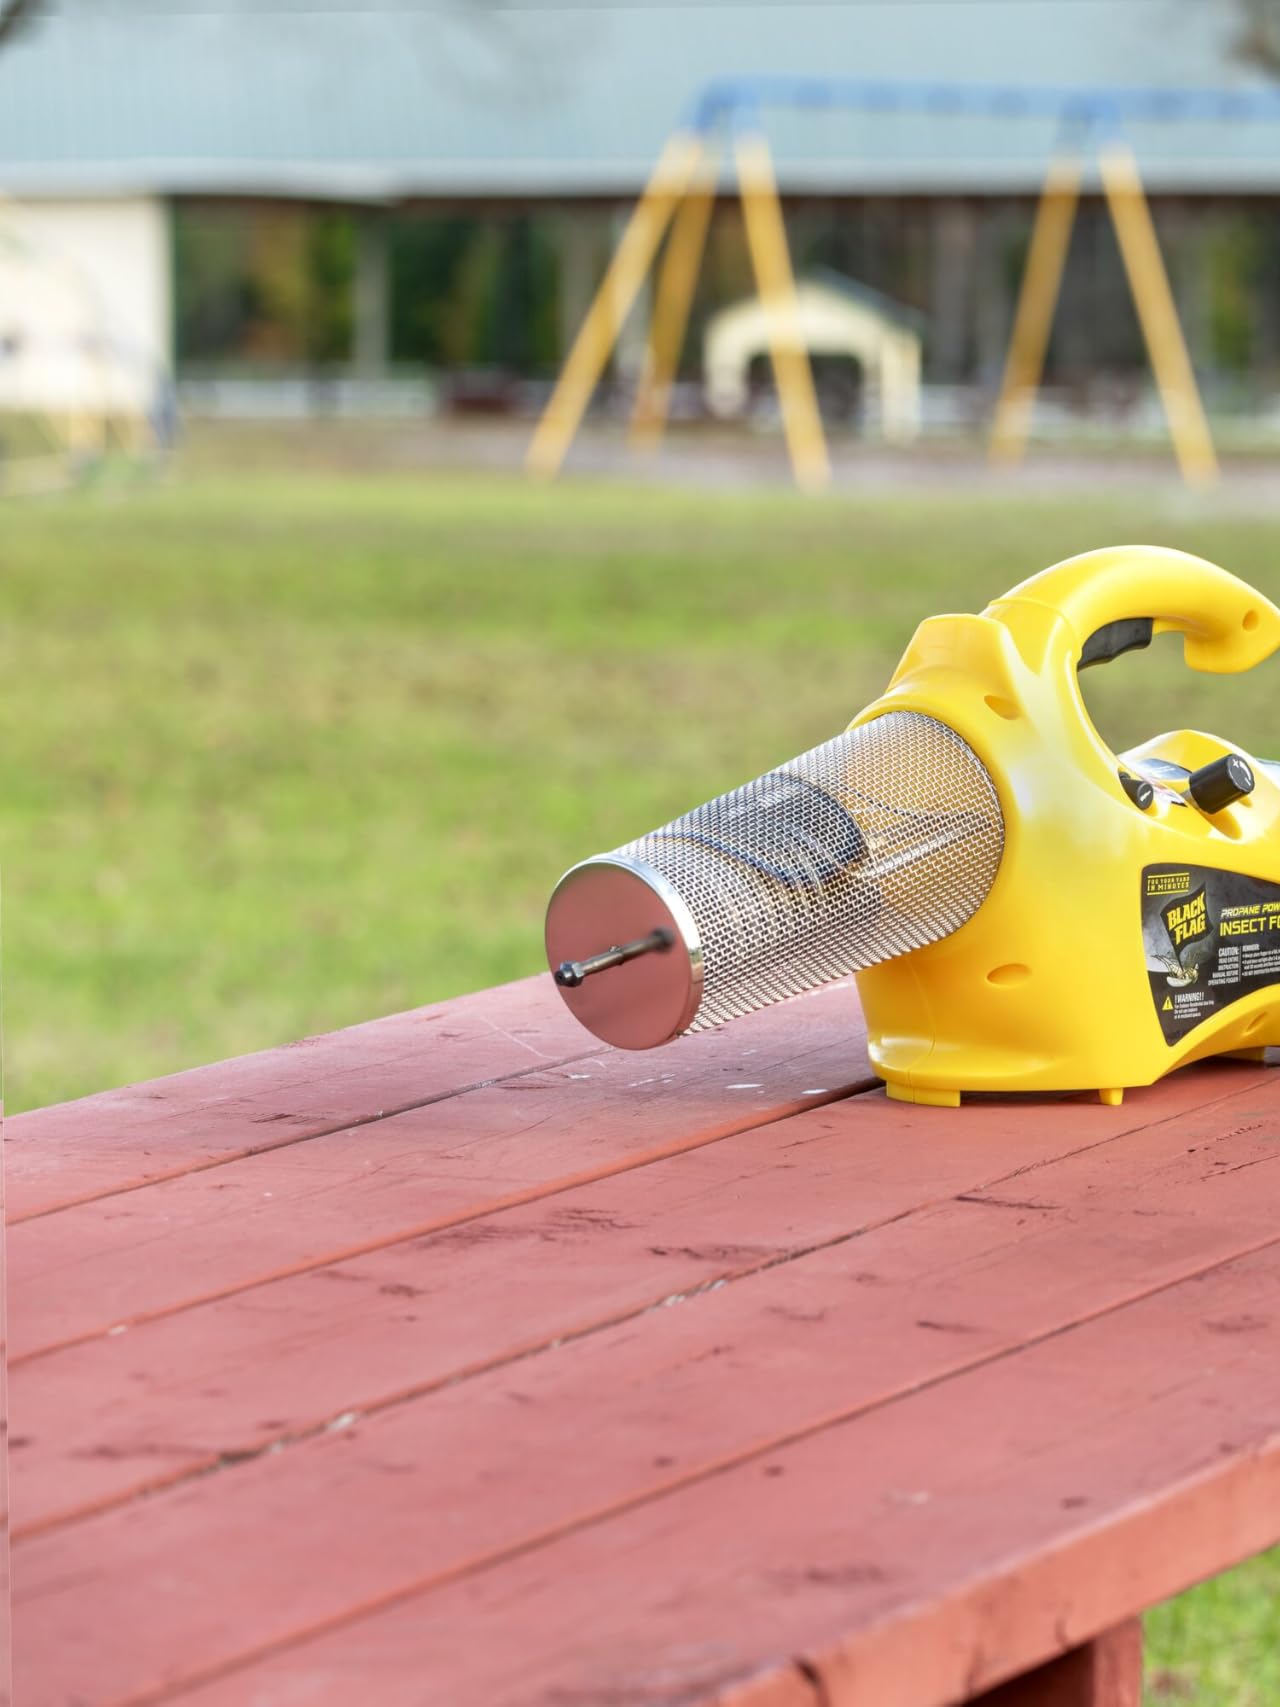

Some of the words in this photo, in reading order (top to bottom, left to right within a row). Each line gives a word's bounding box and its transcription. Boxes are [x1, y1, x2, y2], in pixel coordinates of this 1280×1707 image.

[1158, 882, 1189, 890] MINUTES
[1167, 891, 1206, 931] BLACK
[1220, 904, 1260, 918] PROPANE
[1174, 912, 1206, 945] FLAG
[1220, 917, 1267, 937] INSECT
